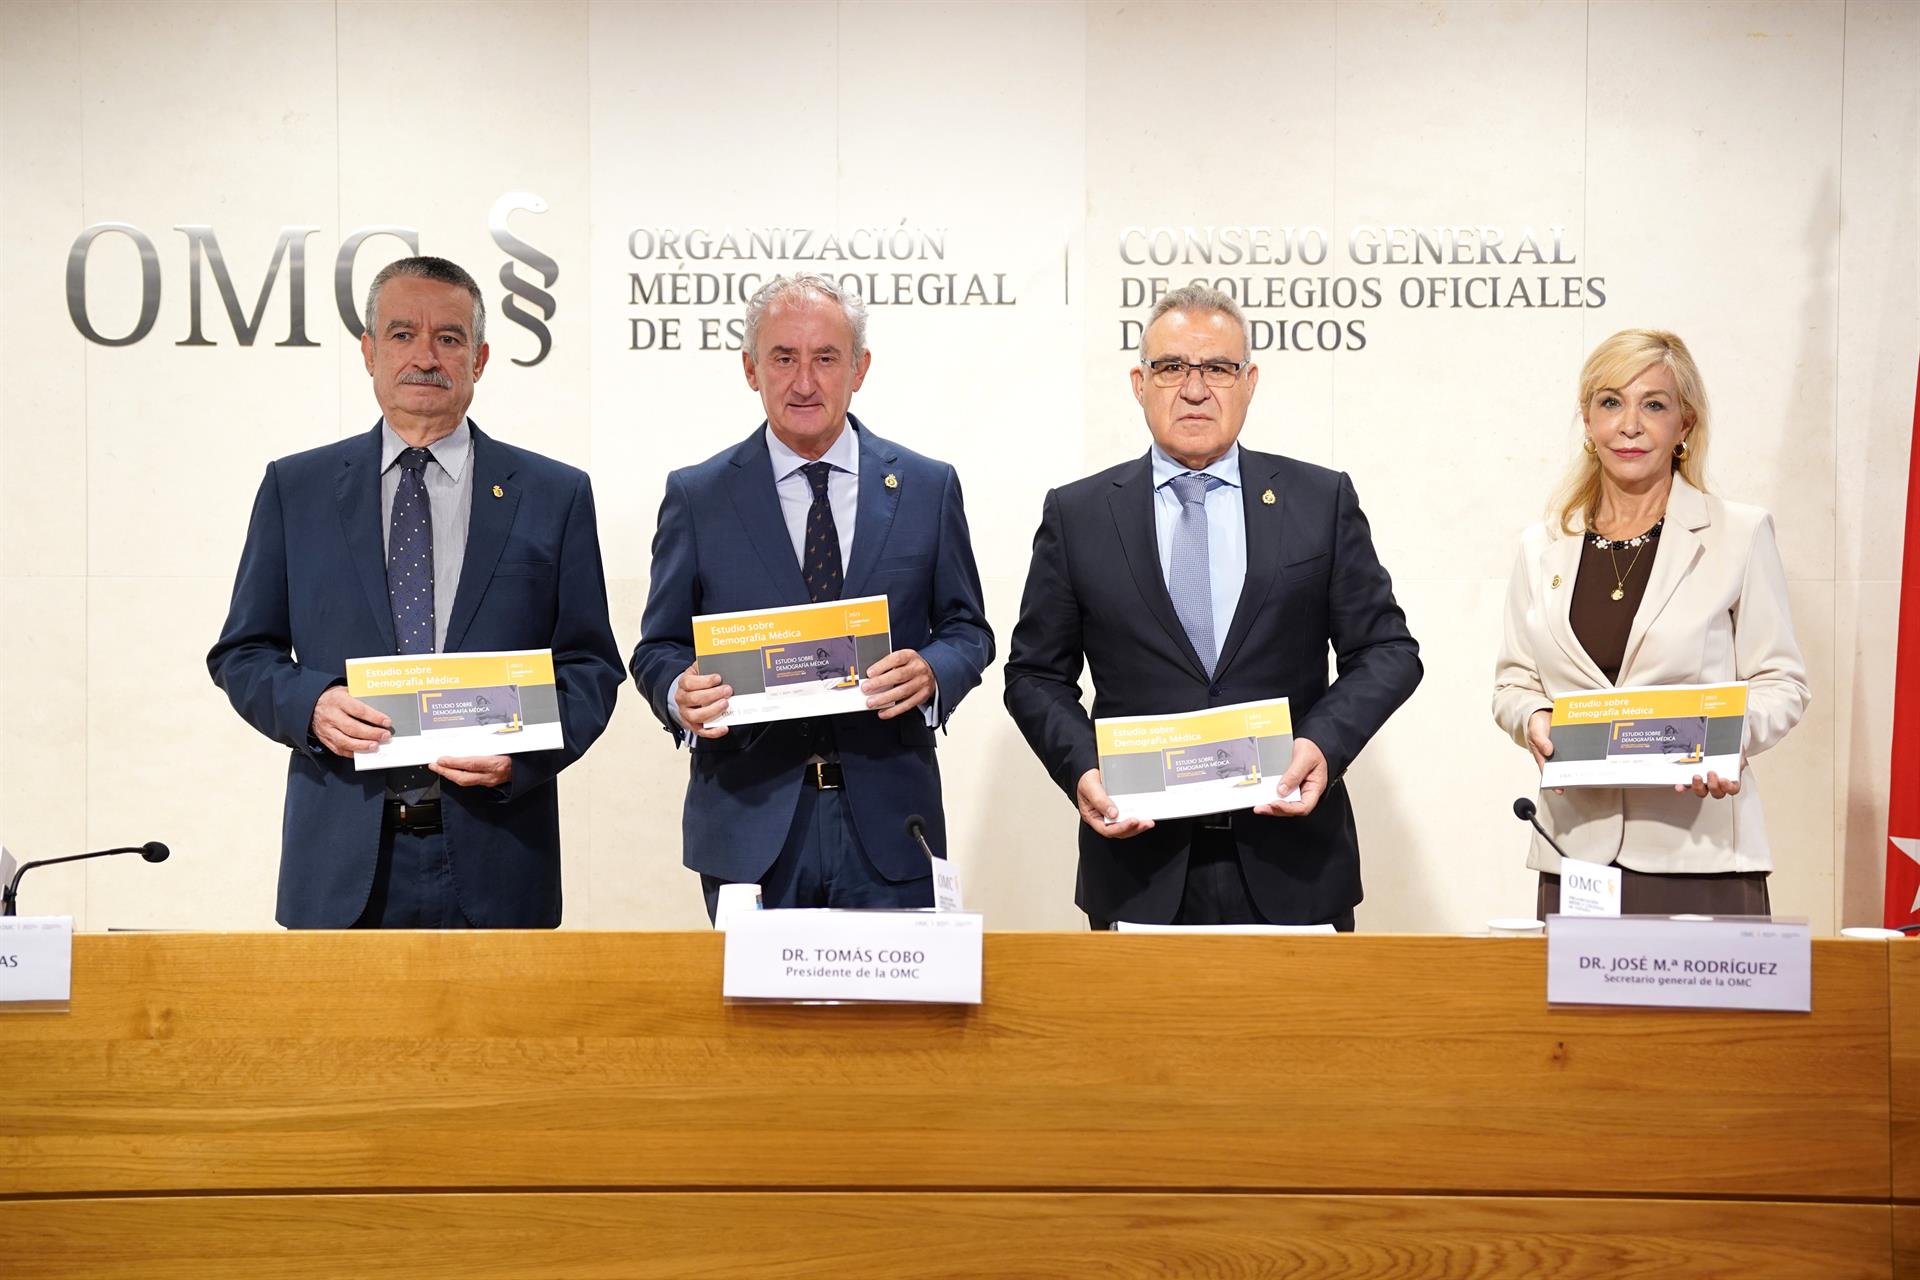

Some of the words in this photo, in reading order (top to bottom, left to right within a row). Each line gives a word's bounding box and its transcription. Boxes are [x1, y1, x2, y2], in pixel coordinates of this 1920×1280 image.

[628, 217, 948, 261] ORGANIZACIÓN
[1119, 225, 1328, 266] CONSEJO
[1347, 226, 1577, 265] GENERAL
[629, 263, 784, 305] MÉDIC
[818, 273, 1016, 305] OLEGIAL
[1400, 276, 1607, 308] OFICIALES
[629, 318, 682, 350] DE
[711, 624, 746, 635] Estudio
[748, 621, 775, 631] sobre
[769, 629, 802, 640] Médica
[775, 657, 797, 665] ESTUDIO
[776, 663, 809, 672] DEMOGRAFÍA
[405, 665, 432, 675] sobre
[1568, 700, 1601, 709] Estudio
[1604, 698, 1630, 707] sobre
[1175, 758, 1197, 766] ESTUDIO
[1568, 874, 1602, 893] OMC
[782, 948, 808, 962] DR.
[814, 946, 872, 963] TOMÁS
[878, 950, 925, 964] COBO
[786, 966, 851, 978] Presidente
[856, 967, 870, 978] de
[875, 967, 886, 978] la
[890, 969, 920, 979] OMC
[1579, 956, 1605, 970] DR.
[1610, 955, 1648, 971] JOSÉ
[1683, 957, 1778, 975] RODRÍGUEZ
[1604, 973, 1655, 984] Secretario
[1658, 974, 1697, 987] general
[1700, 975, 1712, 986] de
[1715, 976, 1725, 986] la
[1728, 977, 1752, 988] OMC
